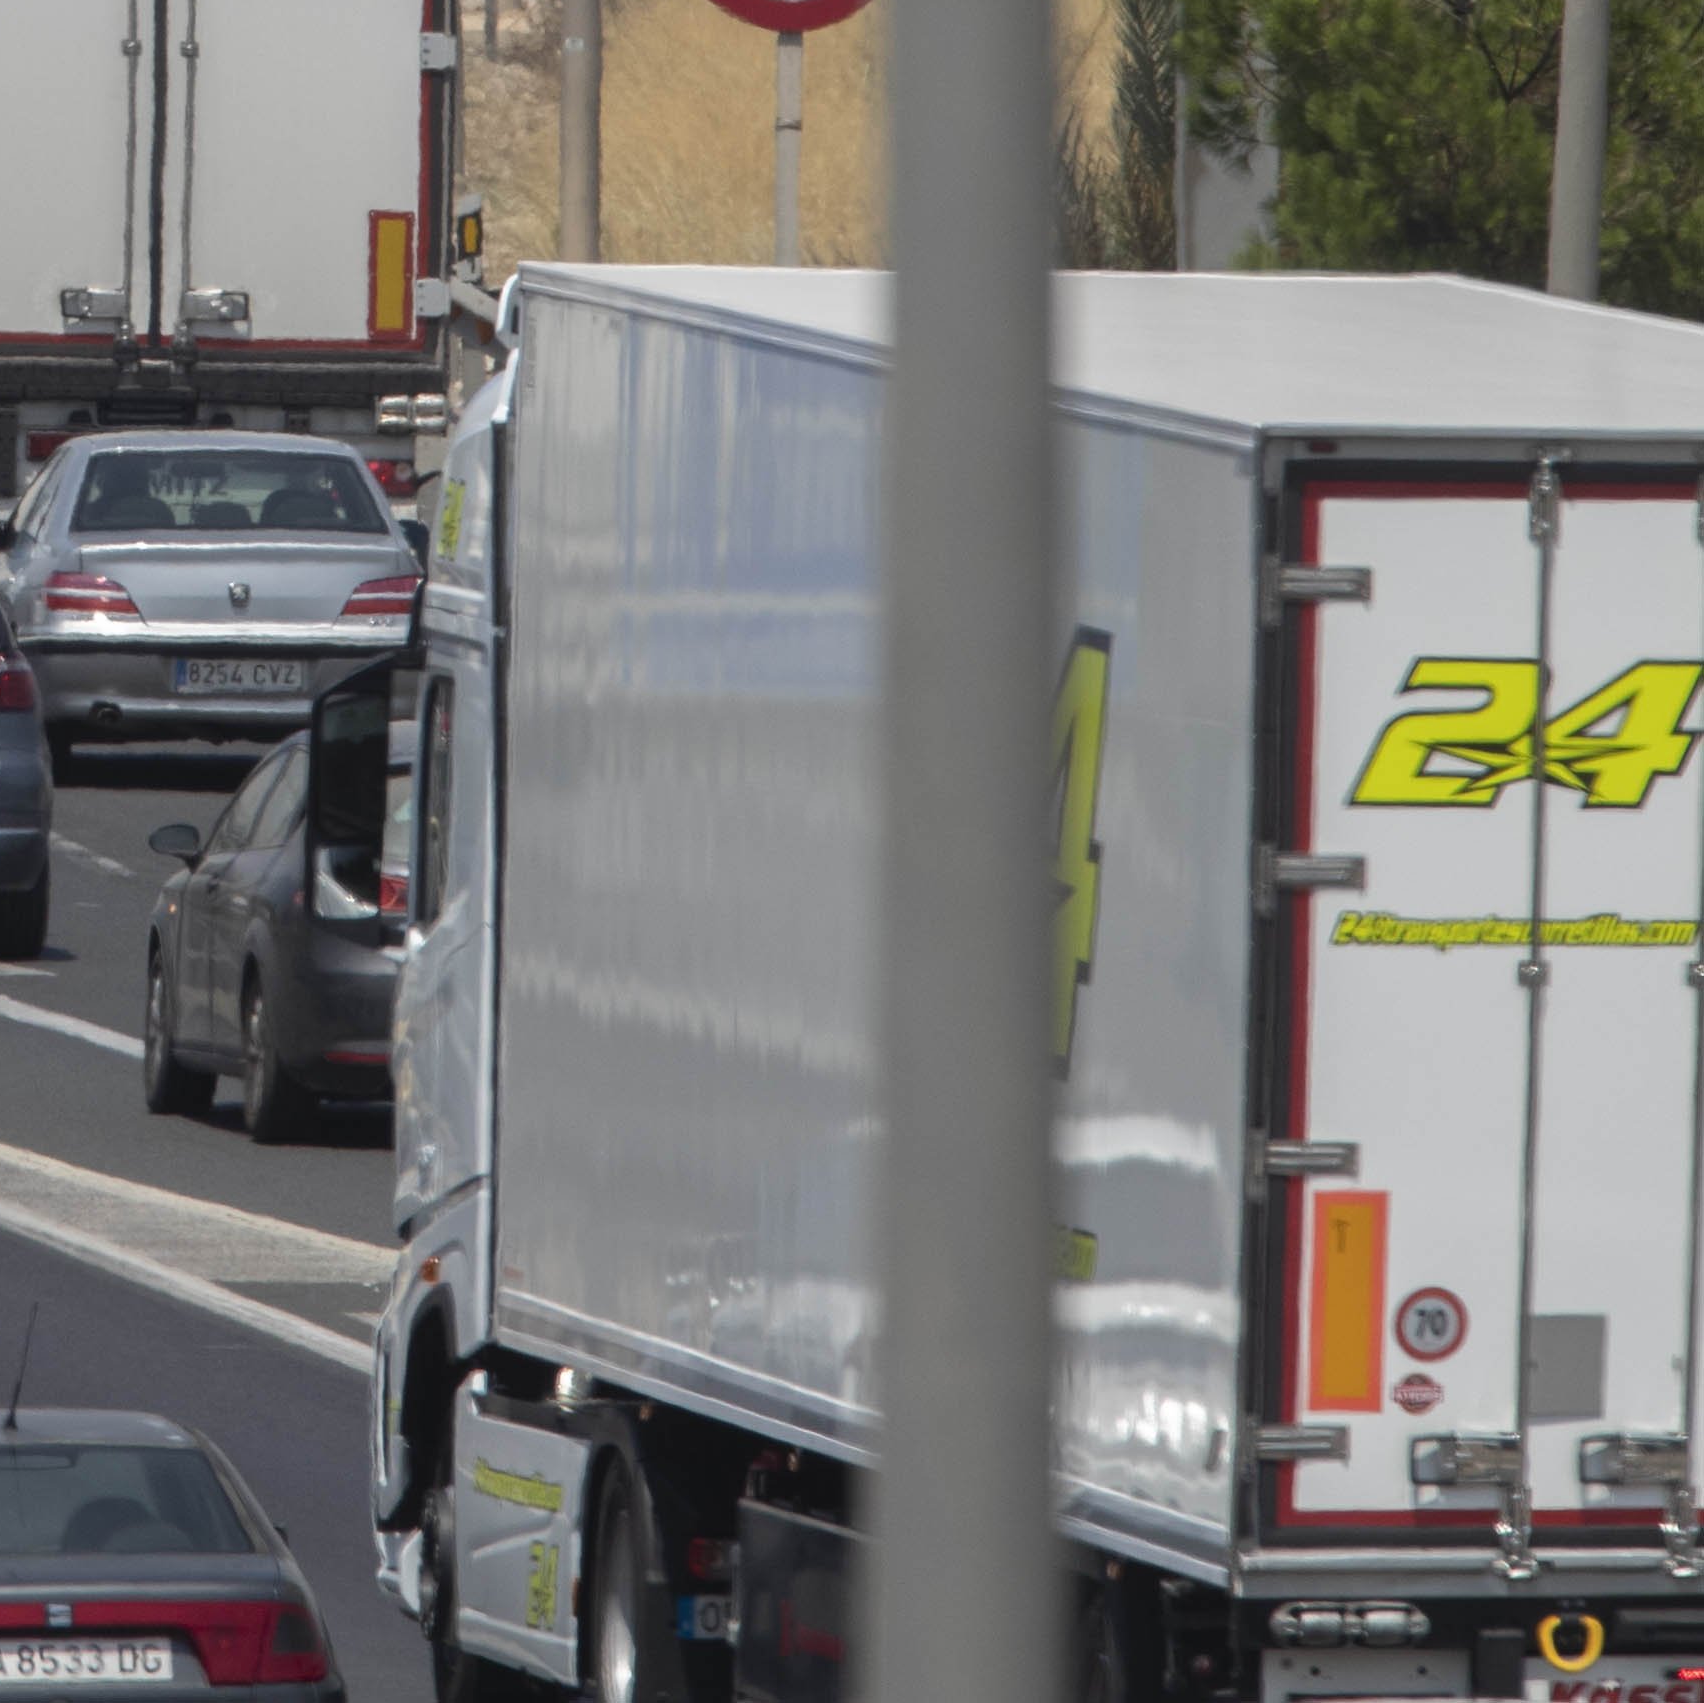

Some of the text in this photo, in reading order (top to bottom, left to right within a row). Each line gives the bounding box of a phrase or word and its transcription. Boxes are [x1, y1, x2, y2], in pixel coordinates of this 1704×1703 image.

[189, 664, 295, 686] 8254 CVZ
[1347, 657, 1704, 809] 24
[1415, 1308, 1448, 1339] 70
[17, 1644, 106, 1676] 8533
[118, 1643, 163, 1674] DG
